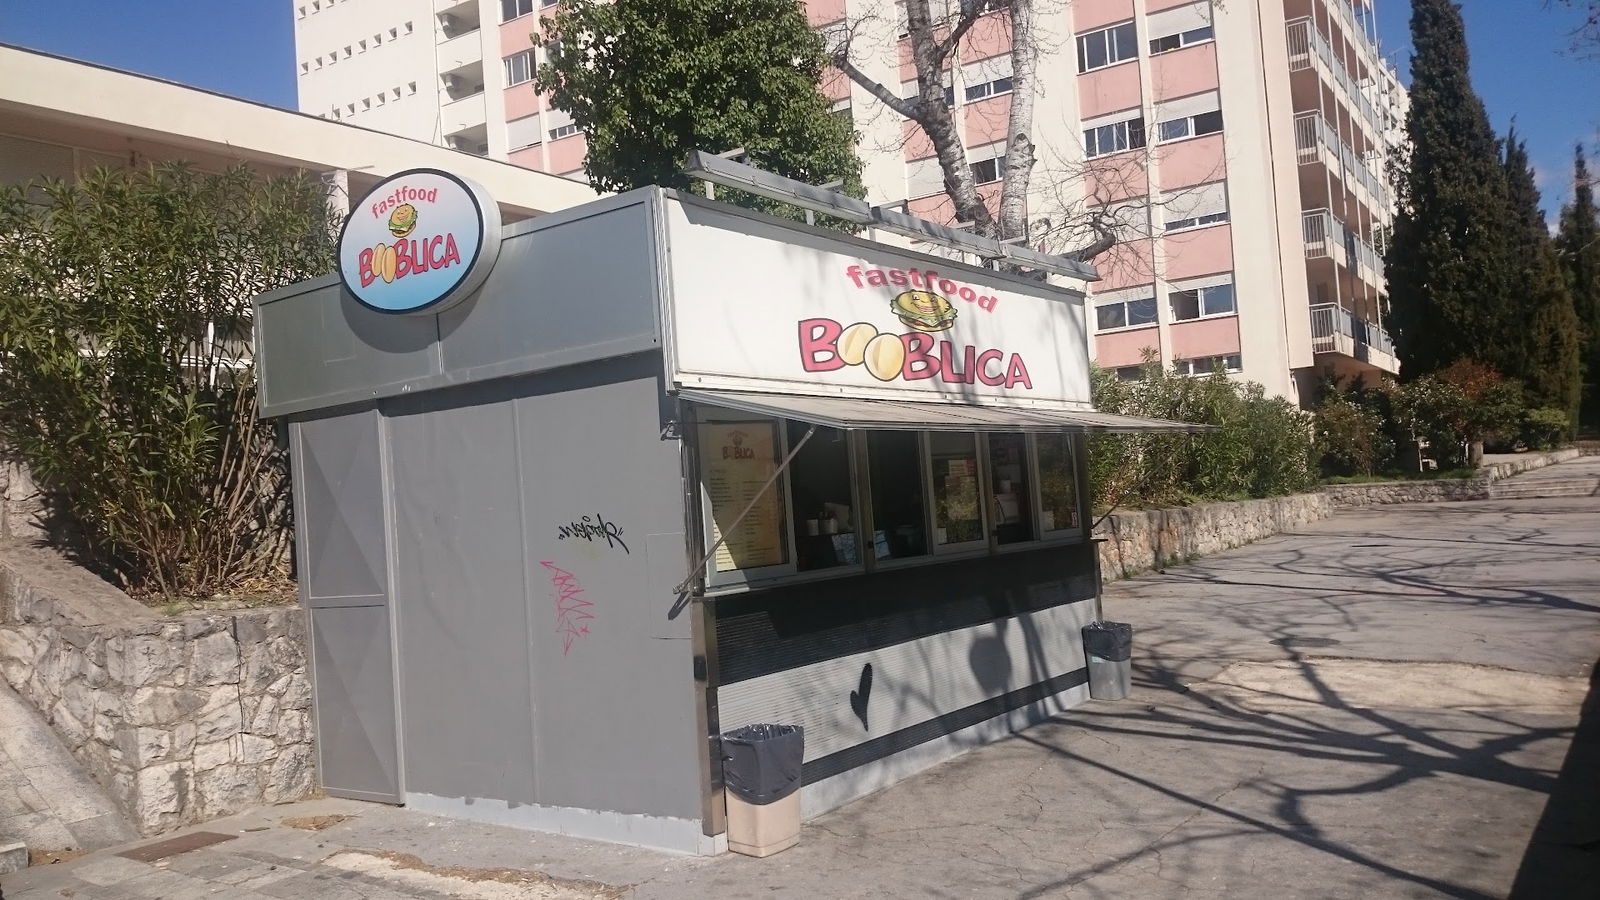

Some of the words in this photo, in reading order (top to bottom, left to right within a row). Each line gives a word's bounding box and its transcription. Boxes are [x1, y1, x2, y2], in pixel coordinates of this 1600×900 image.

[372, 186, 437, 218] fastfood
[359, 233, 460, 288] BOOBLICA
[846, 265, 998, 313] fastfood
[798, 318, 1033, 390] BOOBLICA
